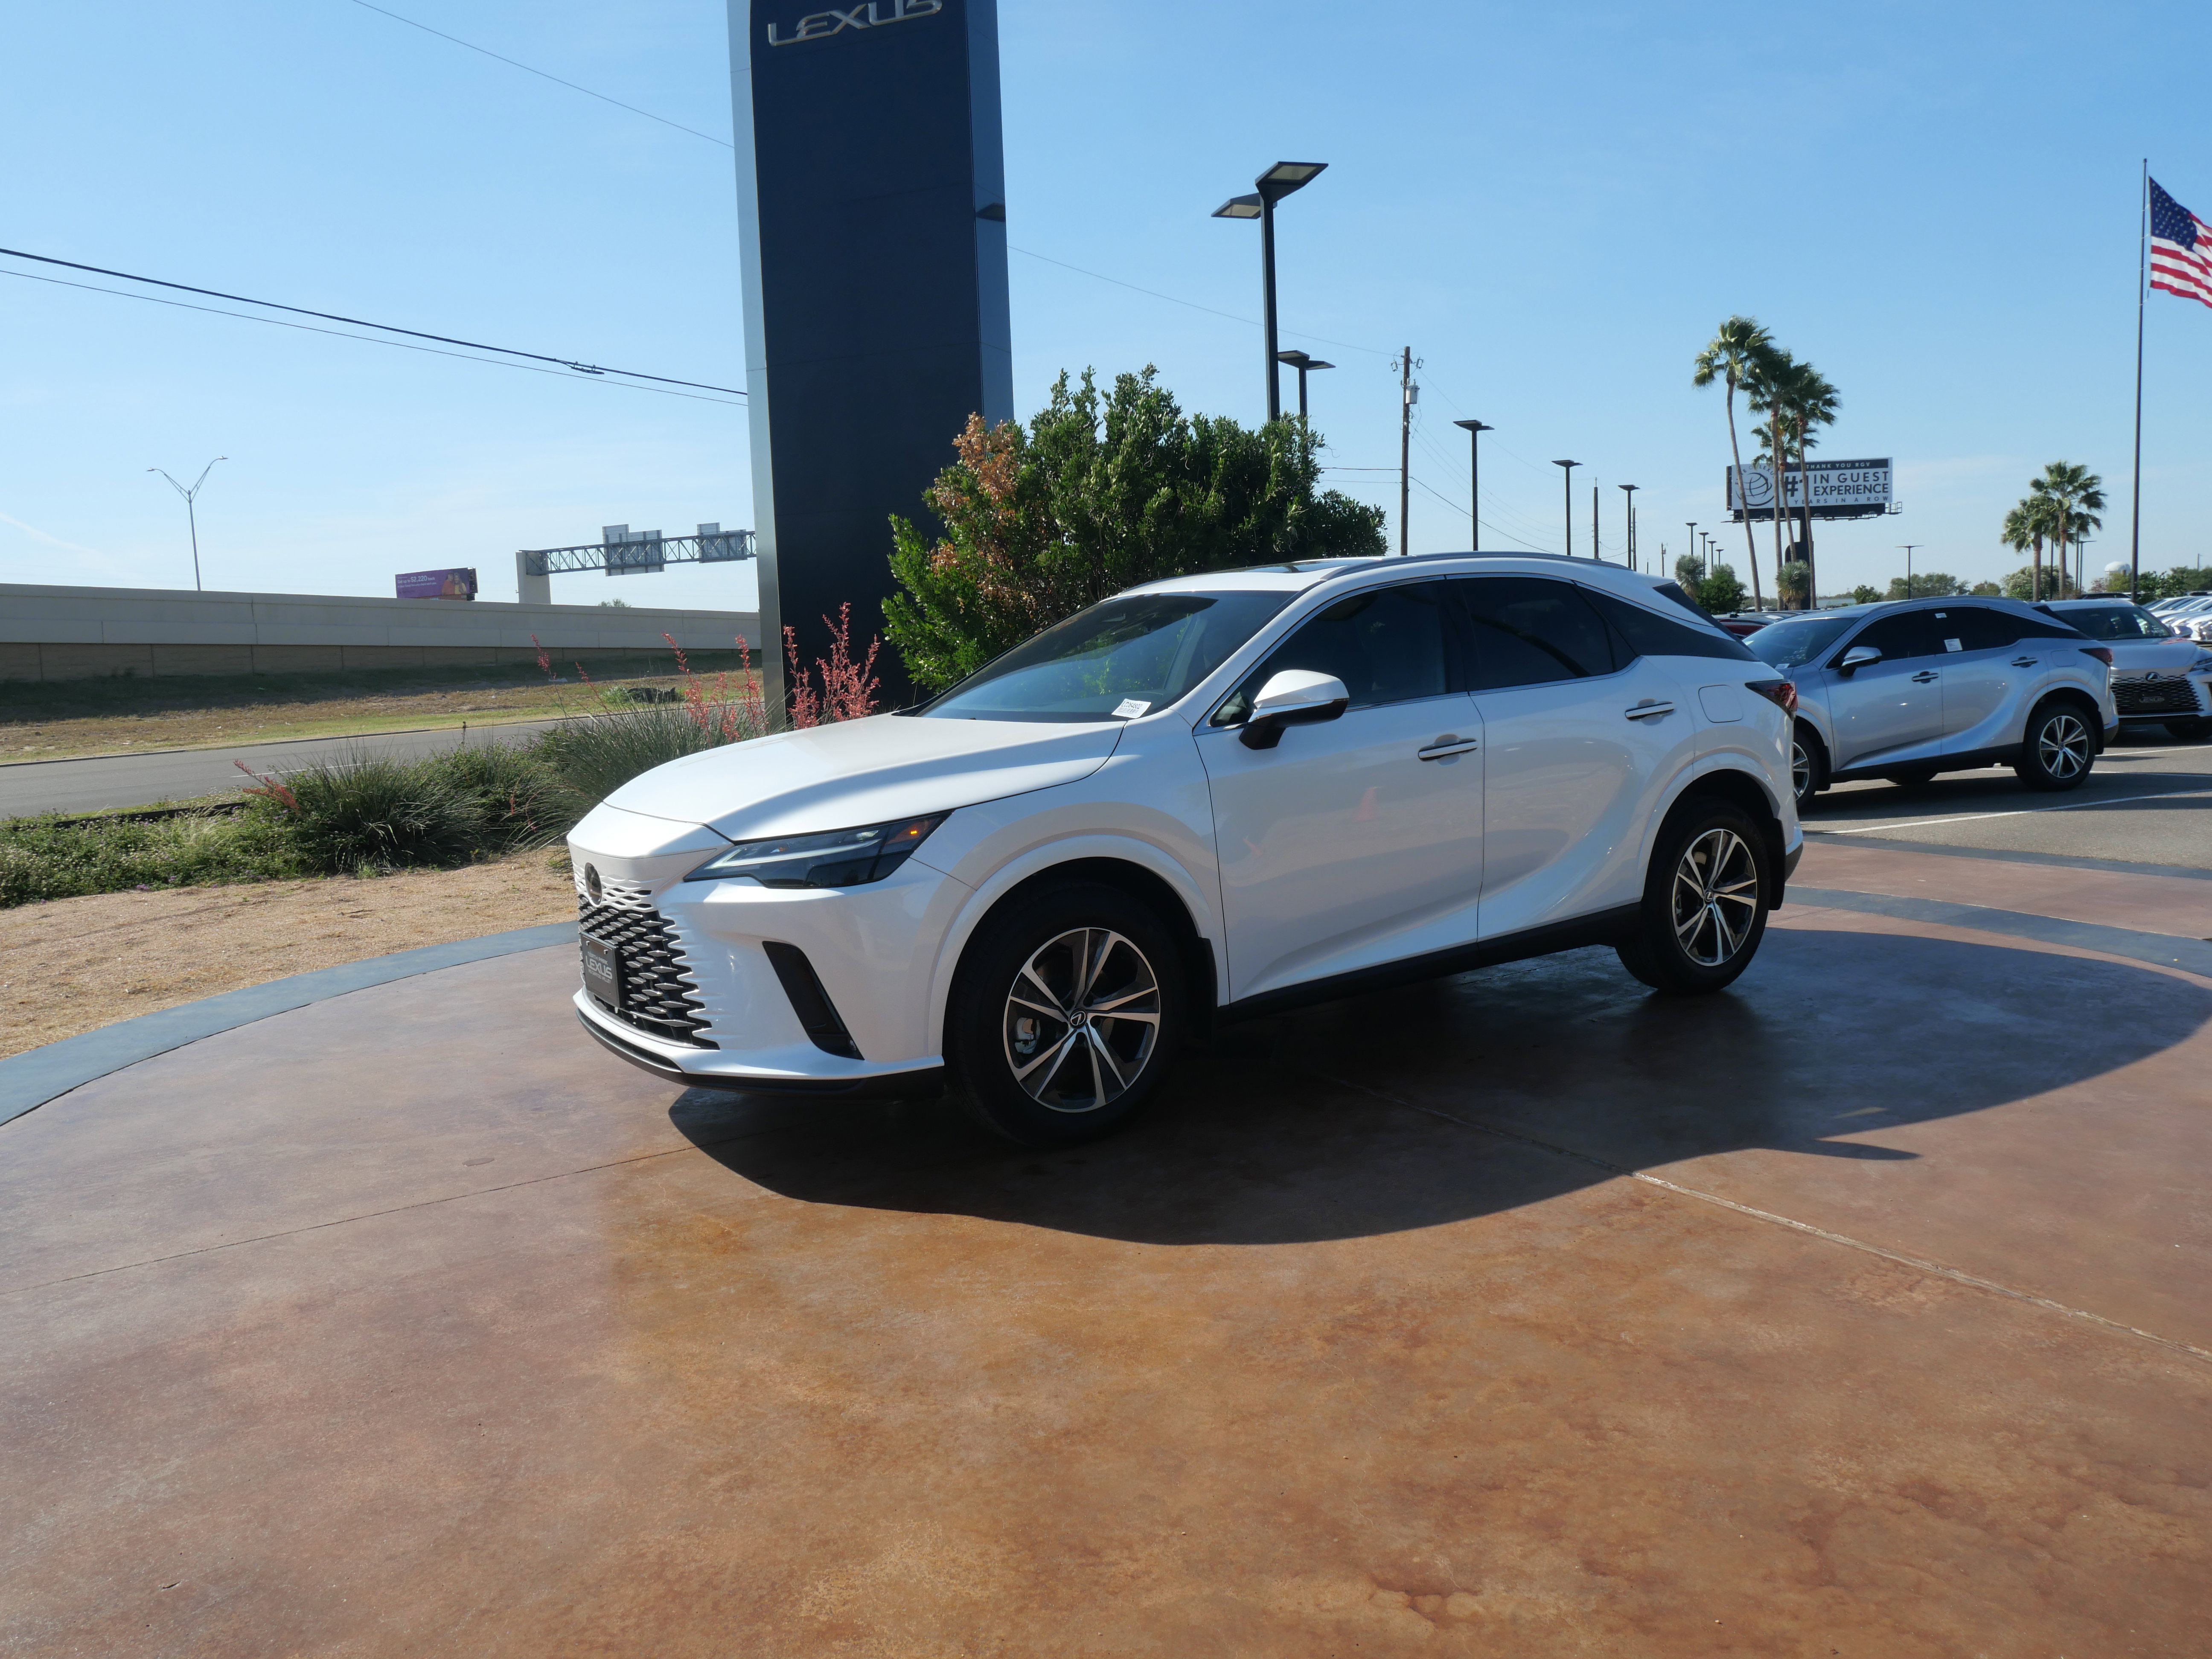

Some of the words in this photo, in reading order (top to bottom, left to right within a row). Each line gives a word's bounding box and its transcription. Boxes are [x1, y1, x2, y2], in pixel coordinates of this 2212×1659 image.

[768, 0, 943, 47] LEXUS
[1814, 474, 1829, 484] IN
[1837, 471, 1889, 483] GUEST
[1814, 483, 1889, 496] EXPERIENCE
[586, 955, 612, 979] LEXUS
